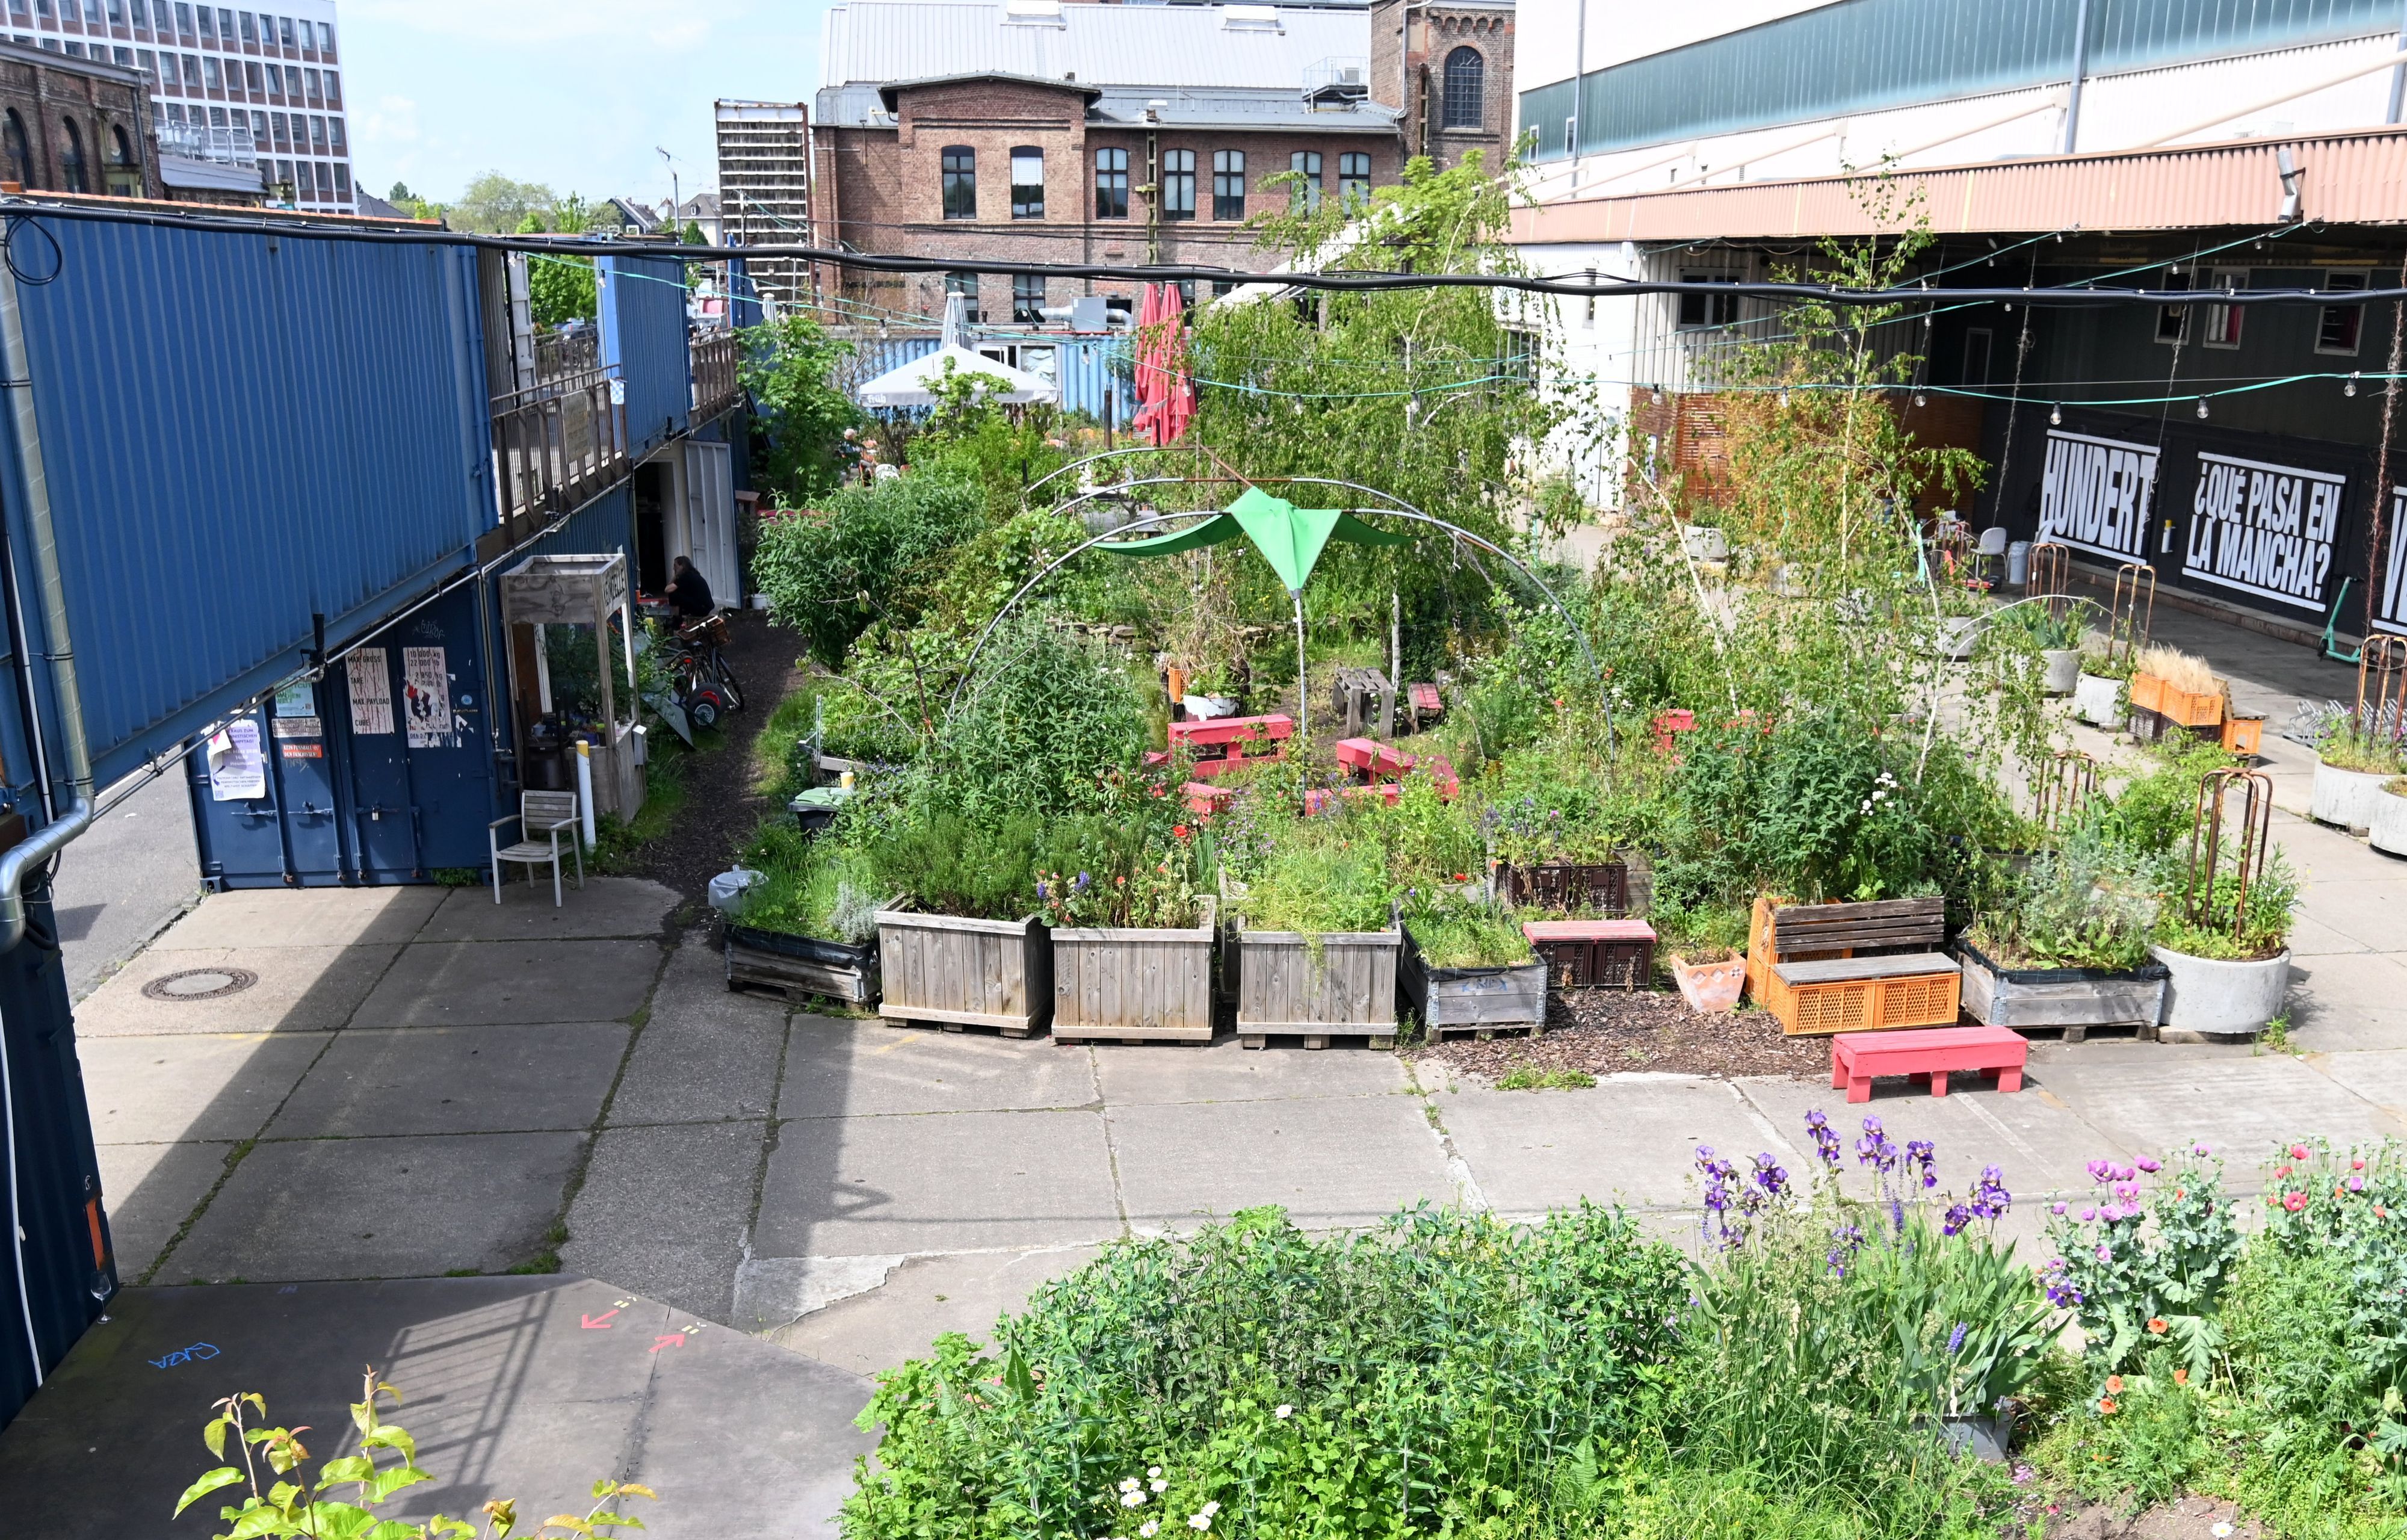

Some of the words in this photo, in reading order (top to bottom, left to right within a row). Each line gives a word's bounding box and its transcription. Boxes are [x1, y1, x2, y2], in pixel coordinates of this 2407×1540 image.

[2039, 438, 2158, 555] HUNDERT
[2194, 462, 2246, 524] ¿QUÉ
[2246, 472, 2302, 536] PASA
[2305, 483, 2341, 543] EN
[2186, 515, 2213, 571] LA
[2216, 521, 2331, 601] MANCHA?
